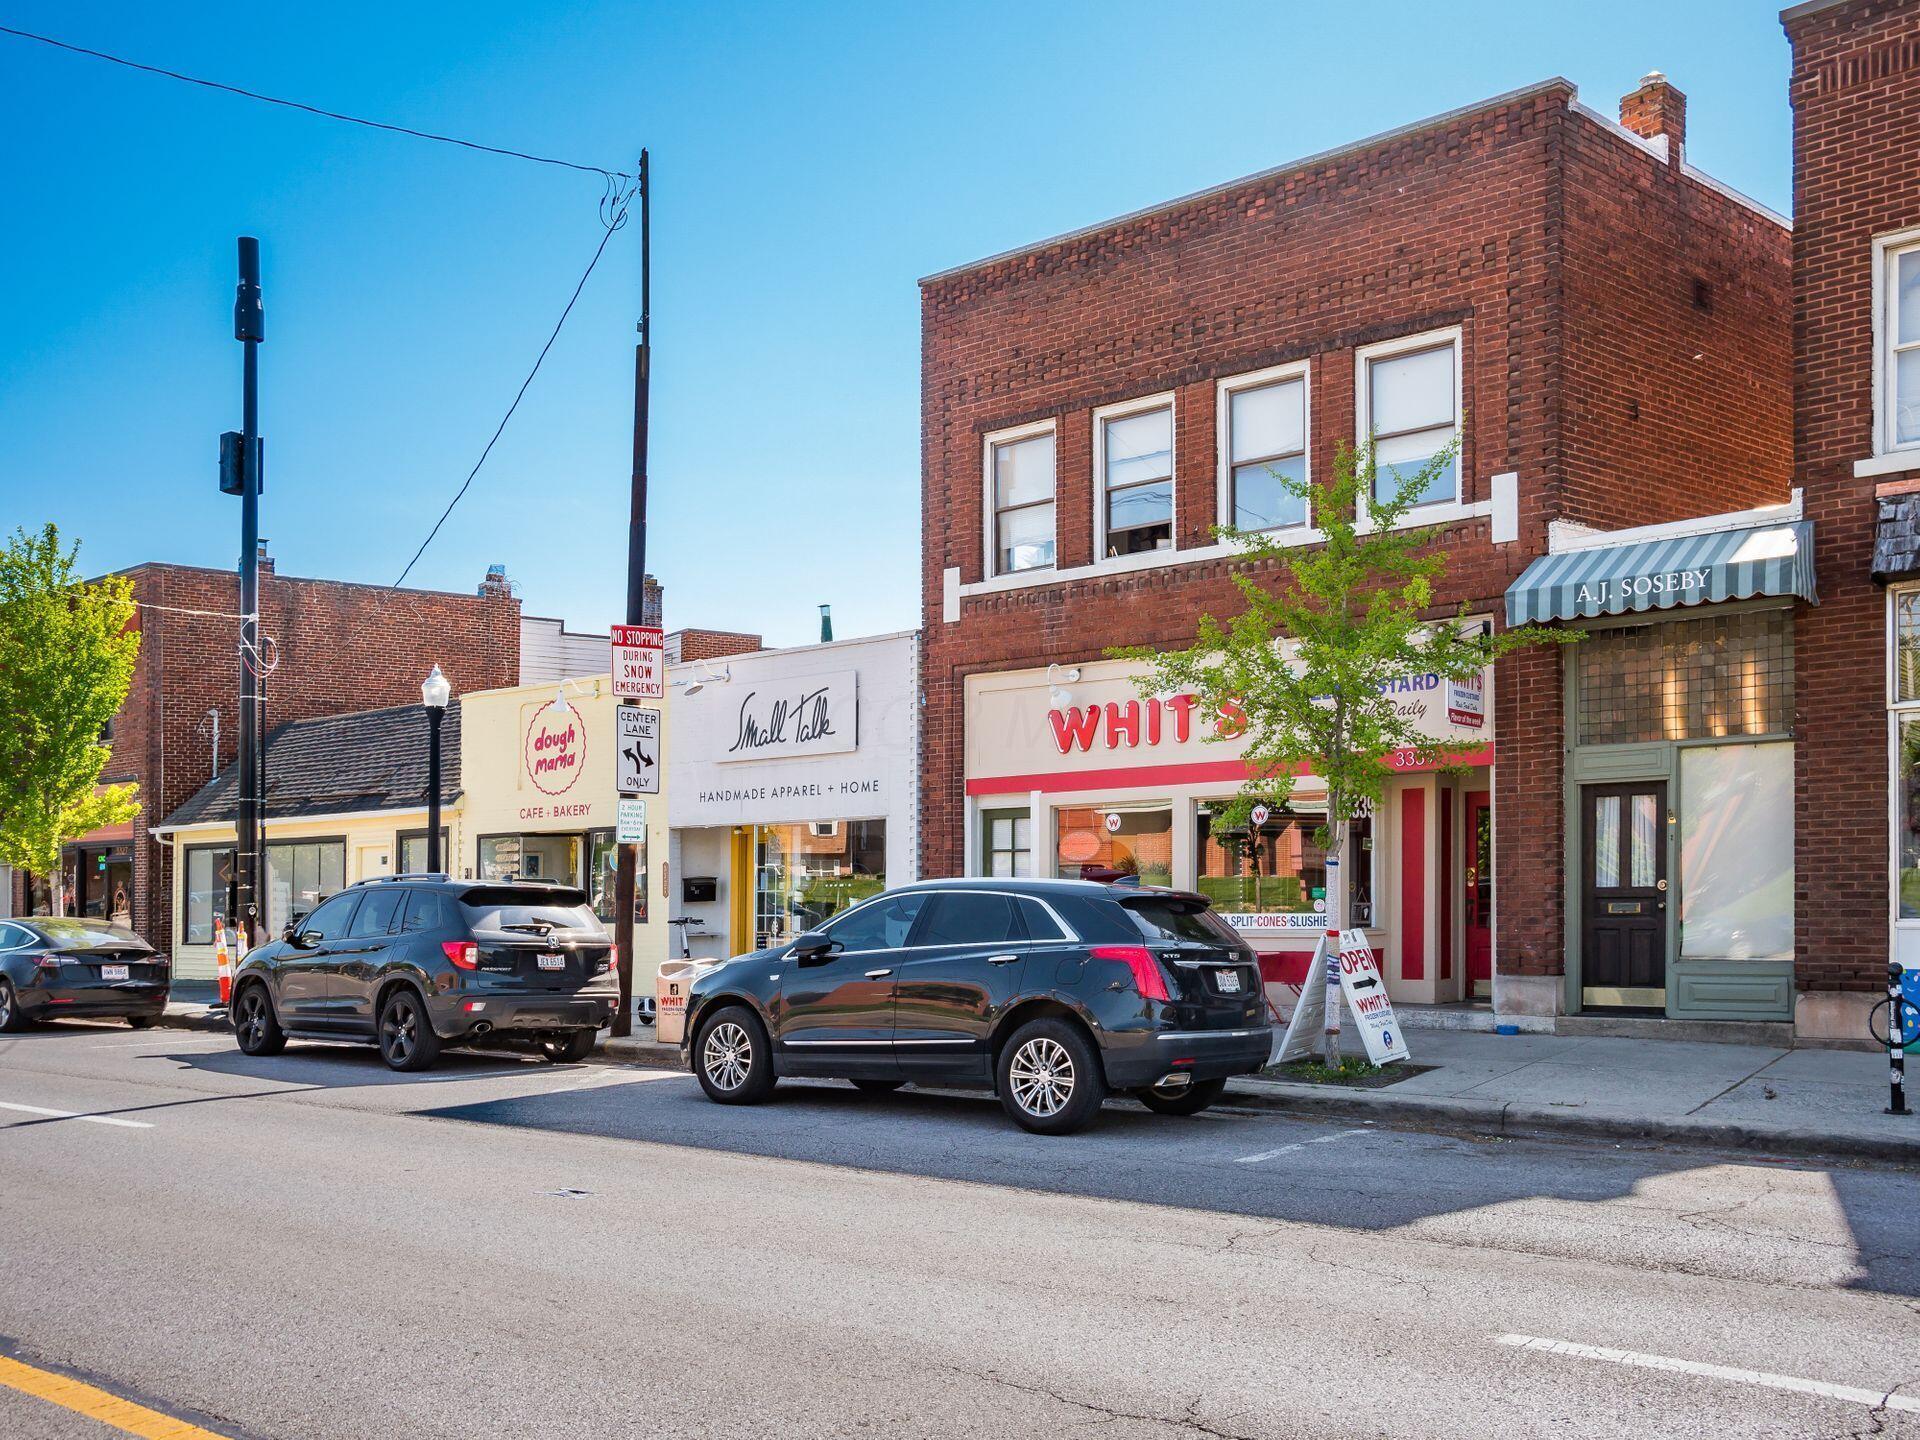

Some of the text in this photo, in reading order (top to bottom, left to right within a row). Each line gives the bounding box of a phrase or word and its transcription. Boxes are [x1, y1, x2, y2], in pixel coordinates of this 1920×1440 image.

[1576, 569, 1711, 605] A.J. SOSEBY
[612, 629, 663, 646] NO STOPPING
[623, 650, 653, 662] DURING
[624, 665, 652, 679] SNOW
[615, 681, 661, 694] EMERGENCY
[1368, 672, 1440, 696] STARD
[620, 711, 657, 724] CENTER
[729, 687, 836, 752] Small Talk
[1048, 690, 1248, 754] WHITS
[534, 723, 576, 753] dough
[625, 724, 651, 735] LANE
[534, 752, 576, 775] mama
[626, 777, 650, 788] ONLY
[700, 787, 766, 803] HANDMADE
[771, 784, 822, 799] APPAREL
[840, 780, 880, 794] HOME
[519, 807, 544, 819] CAFE
[553, 803, 592, 818] BAKERY
[1231, 915, 1254, 927] SPLIT
[1257, 915, 1287, 927] CONES
[1339, 948, 1376, 975] OPEN
[1355, 993, 1390, 1013] WHIT'S
